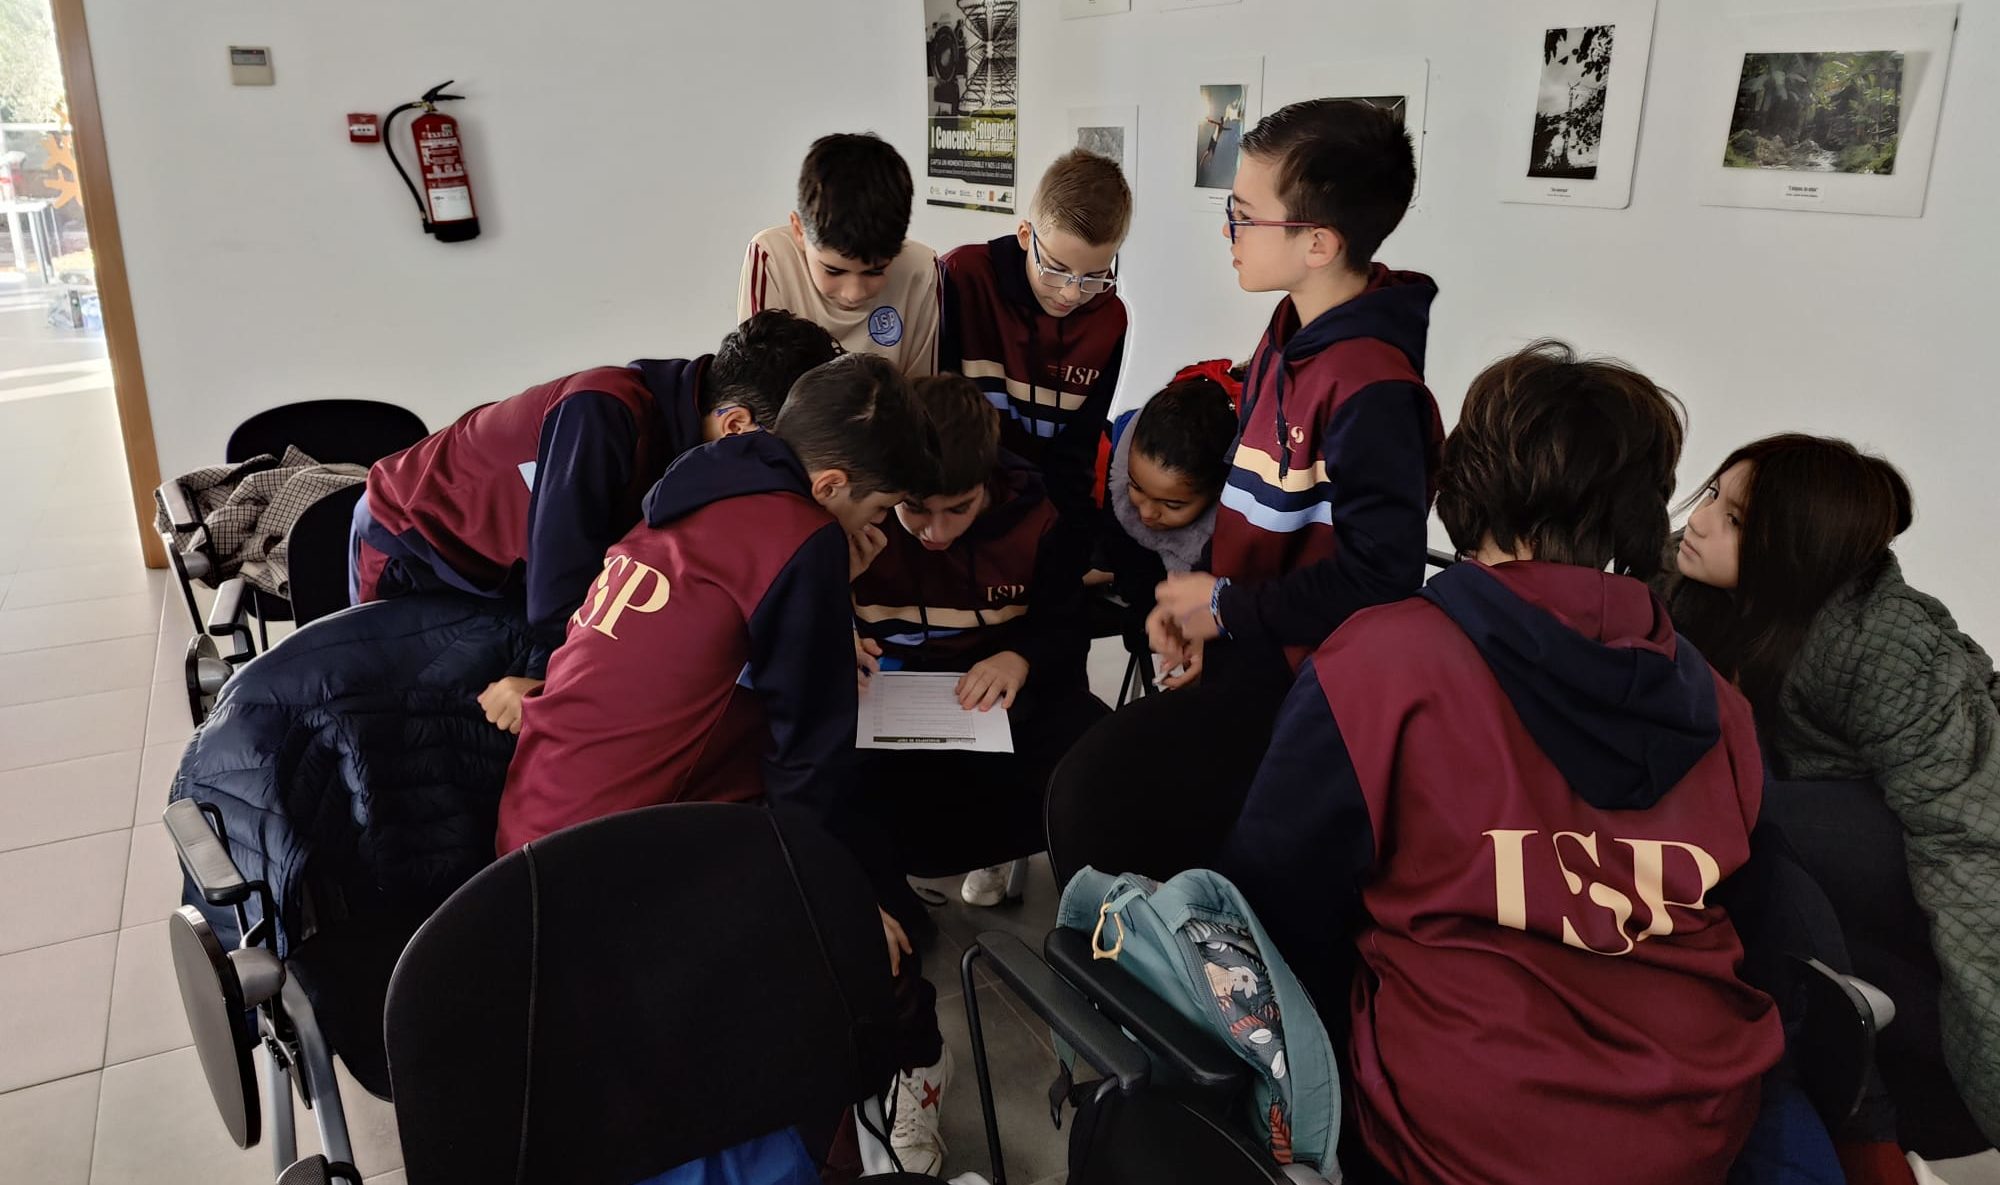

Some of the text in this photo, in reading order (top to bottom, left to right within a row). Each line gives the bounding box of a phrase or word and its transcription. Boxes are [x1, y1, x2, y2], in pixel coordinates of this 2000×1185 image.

[931, 126, 976, 151] I Concurso
[874, 311, 895, 331] ISP
[1064, 365, 1100, 385] ISP
[986, 584, 1025, 602] ISP
[1481, 829, 1720, 956] ISP
